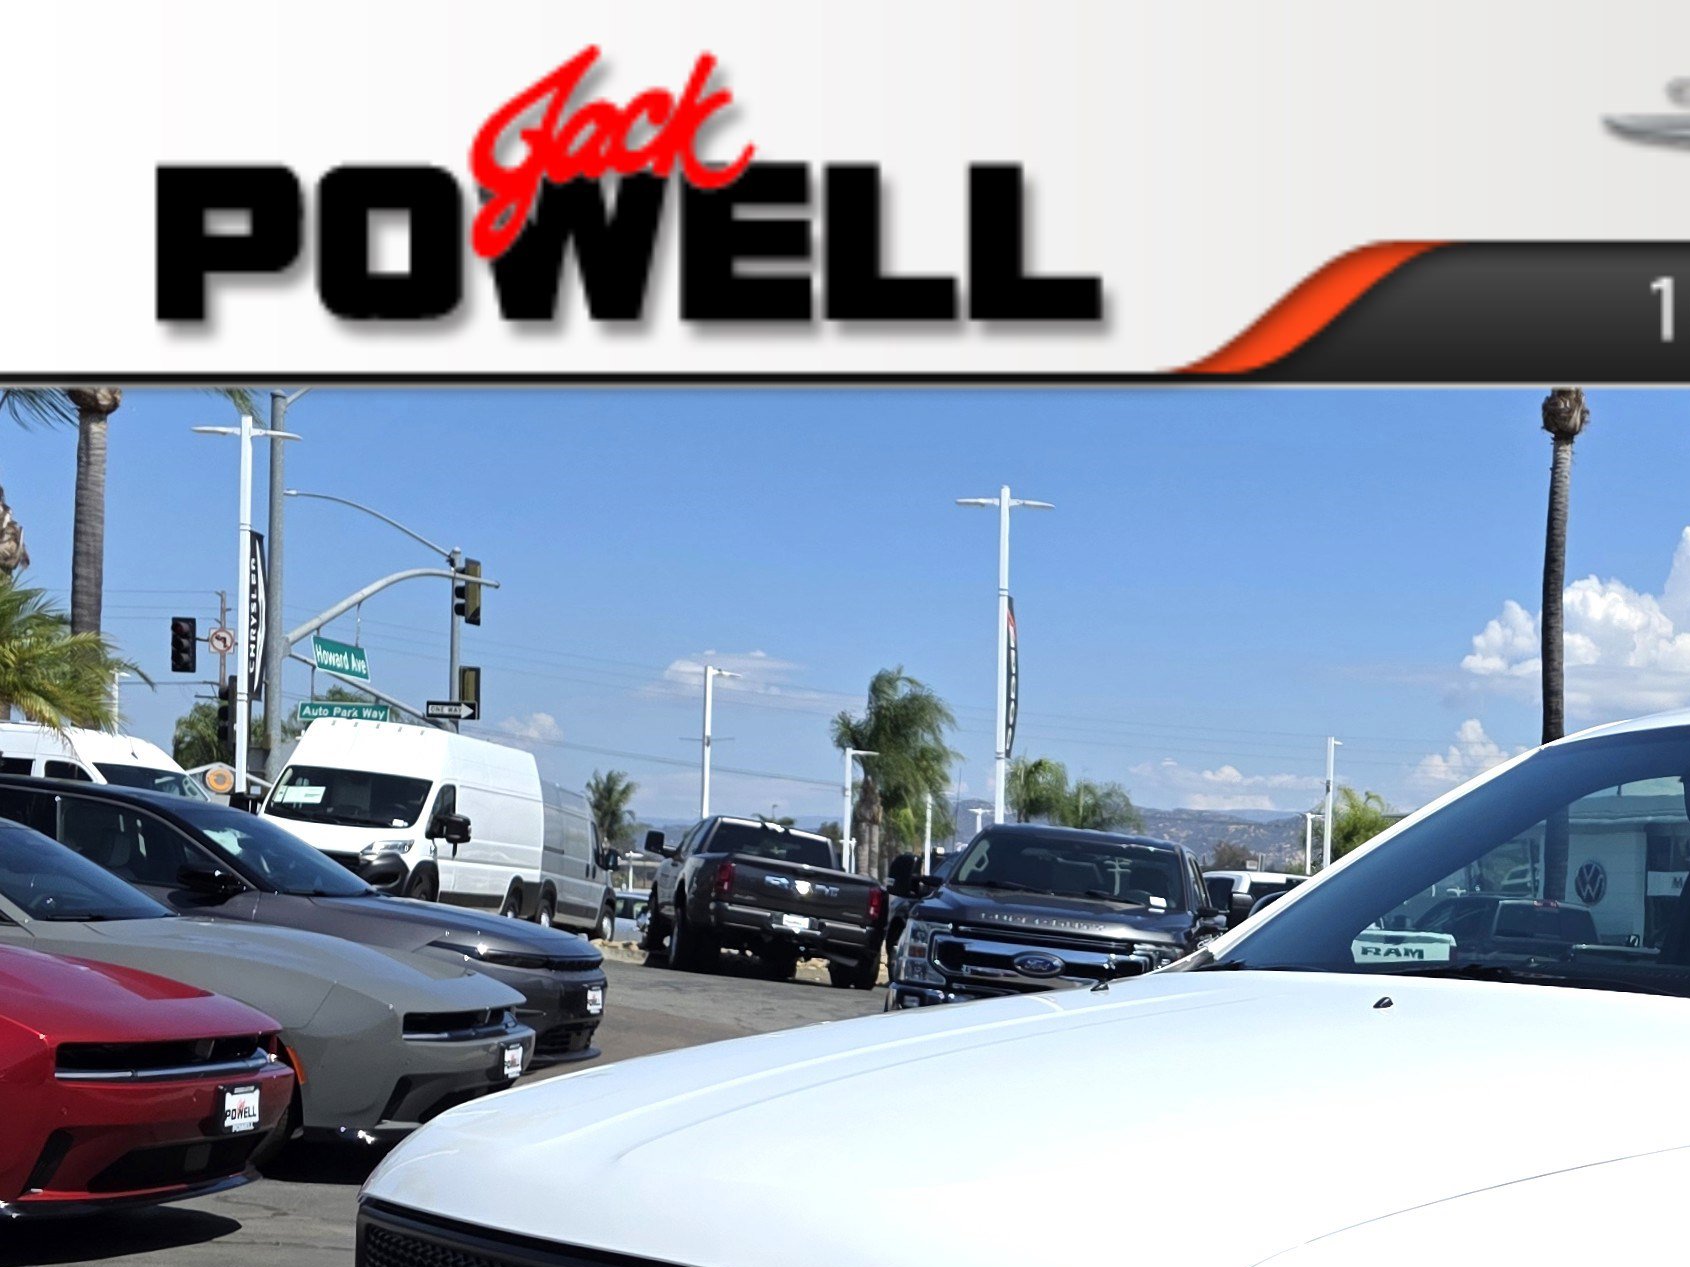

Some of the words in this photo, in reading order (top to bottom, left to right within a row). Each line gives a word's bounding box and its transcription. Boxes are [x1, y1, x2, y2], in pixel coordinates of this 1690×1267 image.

[315, 643, 350, 670] Howard
[351, 652, 367, 675] Ave
[302, 705, 329, 718] Auto
[333, 705, 358, 718] Park
[362, 706, 386, 720] Way
[430, 705, 445, 713] ONE
[1360, 945, 1425, 960] RAM
[225, 1105, 257, 1120] POWELL
